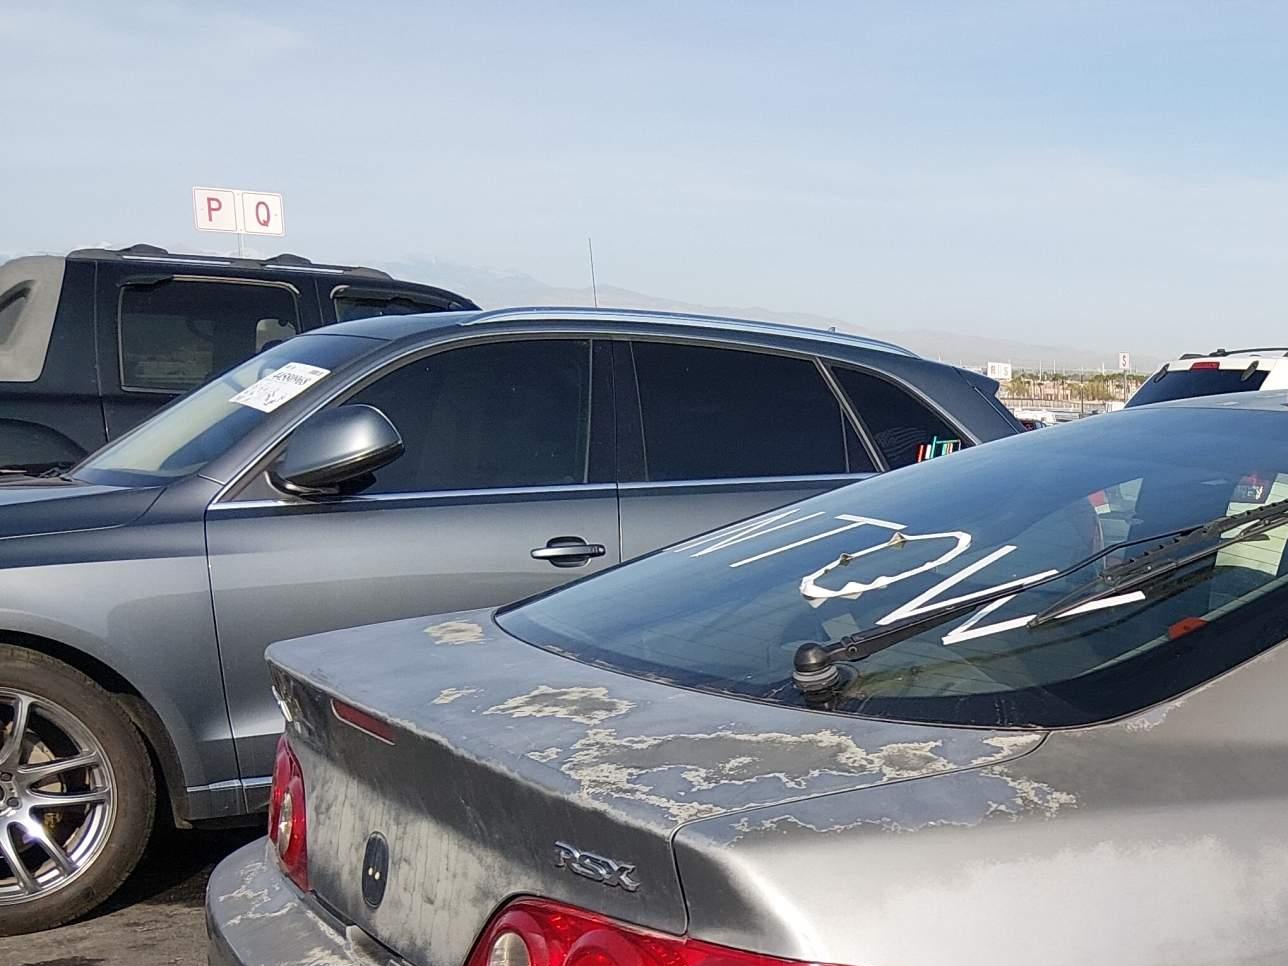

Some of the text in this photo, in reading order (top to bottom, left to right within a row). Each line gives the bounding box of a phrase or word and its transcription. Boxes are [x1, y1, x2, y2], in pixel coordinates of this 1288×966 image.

[207, 197, 222, 222] P
[255, 201, 271, 227] Q
[729, 513, 1146, 645] TOW
[554, 841, 641, 892] RSX
